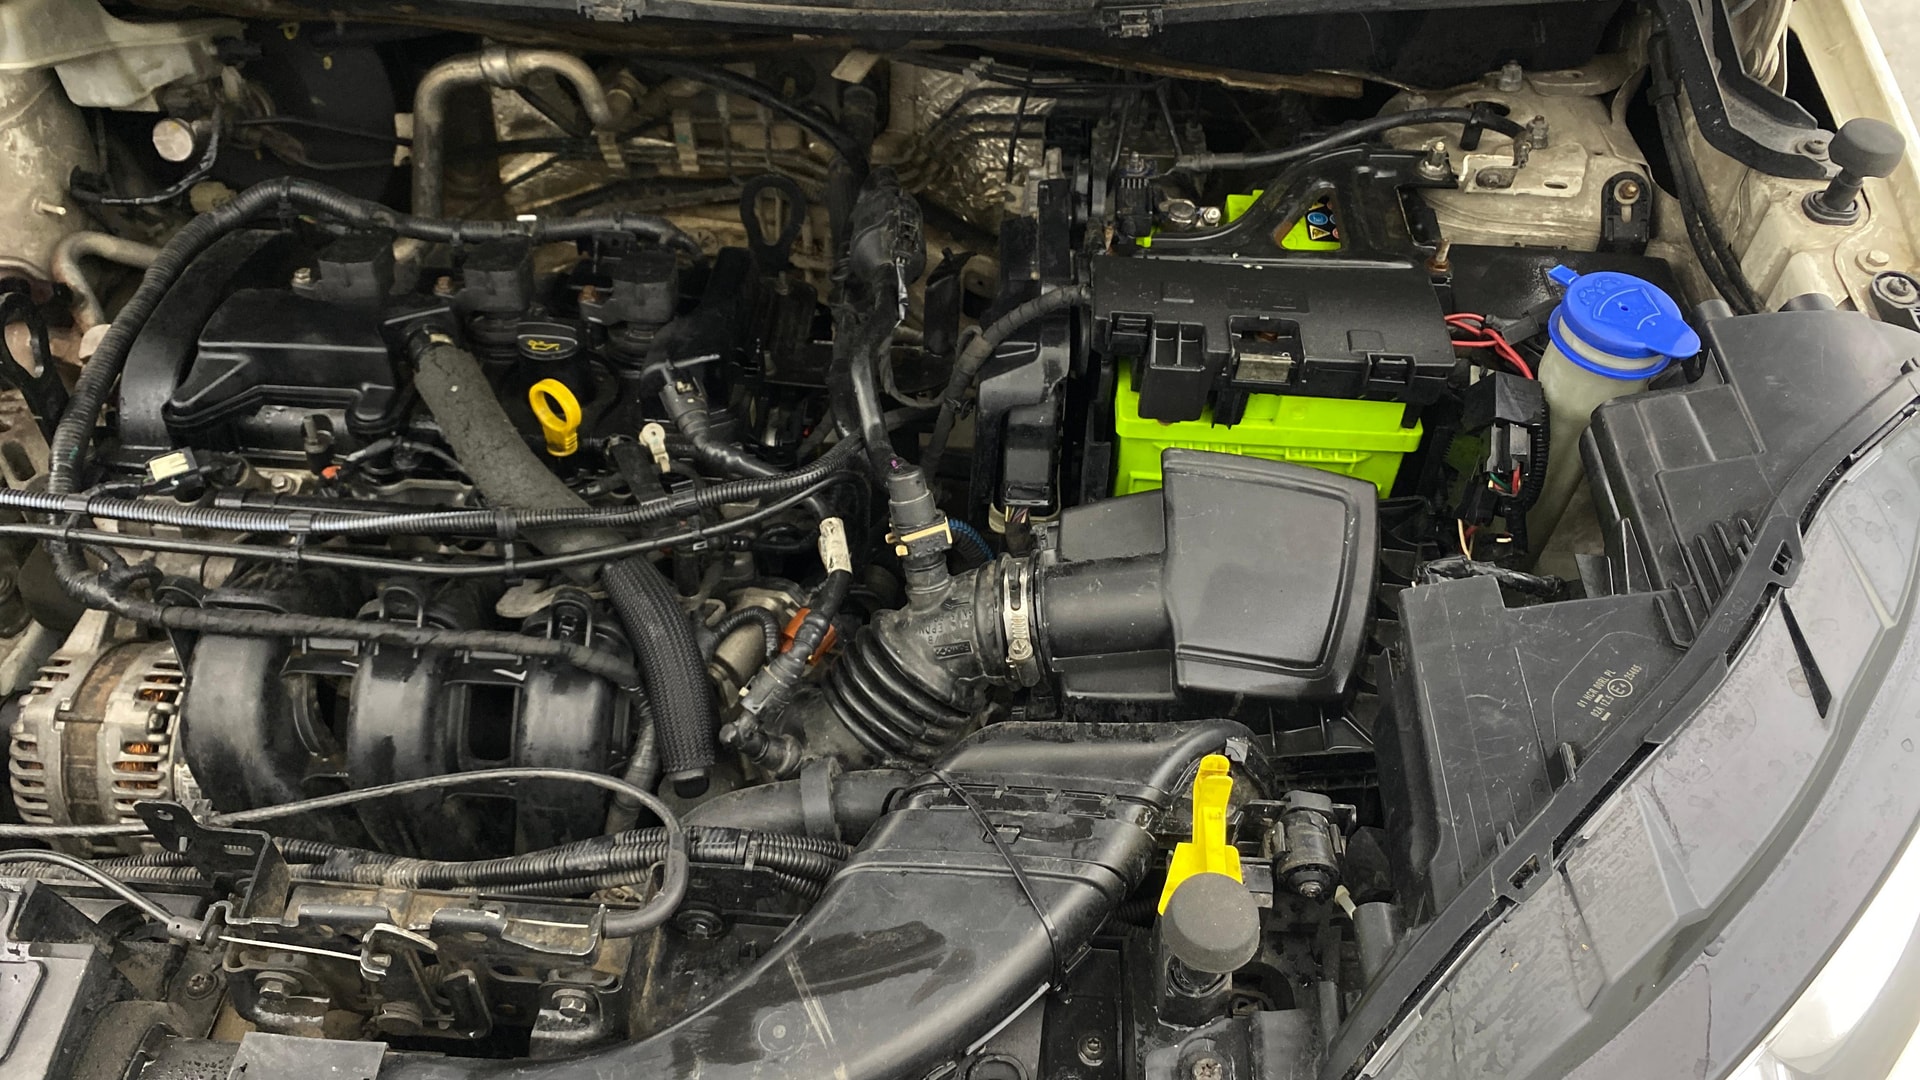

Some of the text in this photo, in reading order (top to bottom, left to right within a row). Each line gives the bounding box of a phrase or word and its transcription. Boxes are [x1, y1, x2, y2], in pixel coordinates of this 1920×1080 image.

[1576, 699, 1588, 708] 01
[1582, 688, 1599, 701] HCR
[1604, 669, 1617, 677] PL
